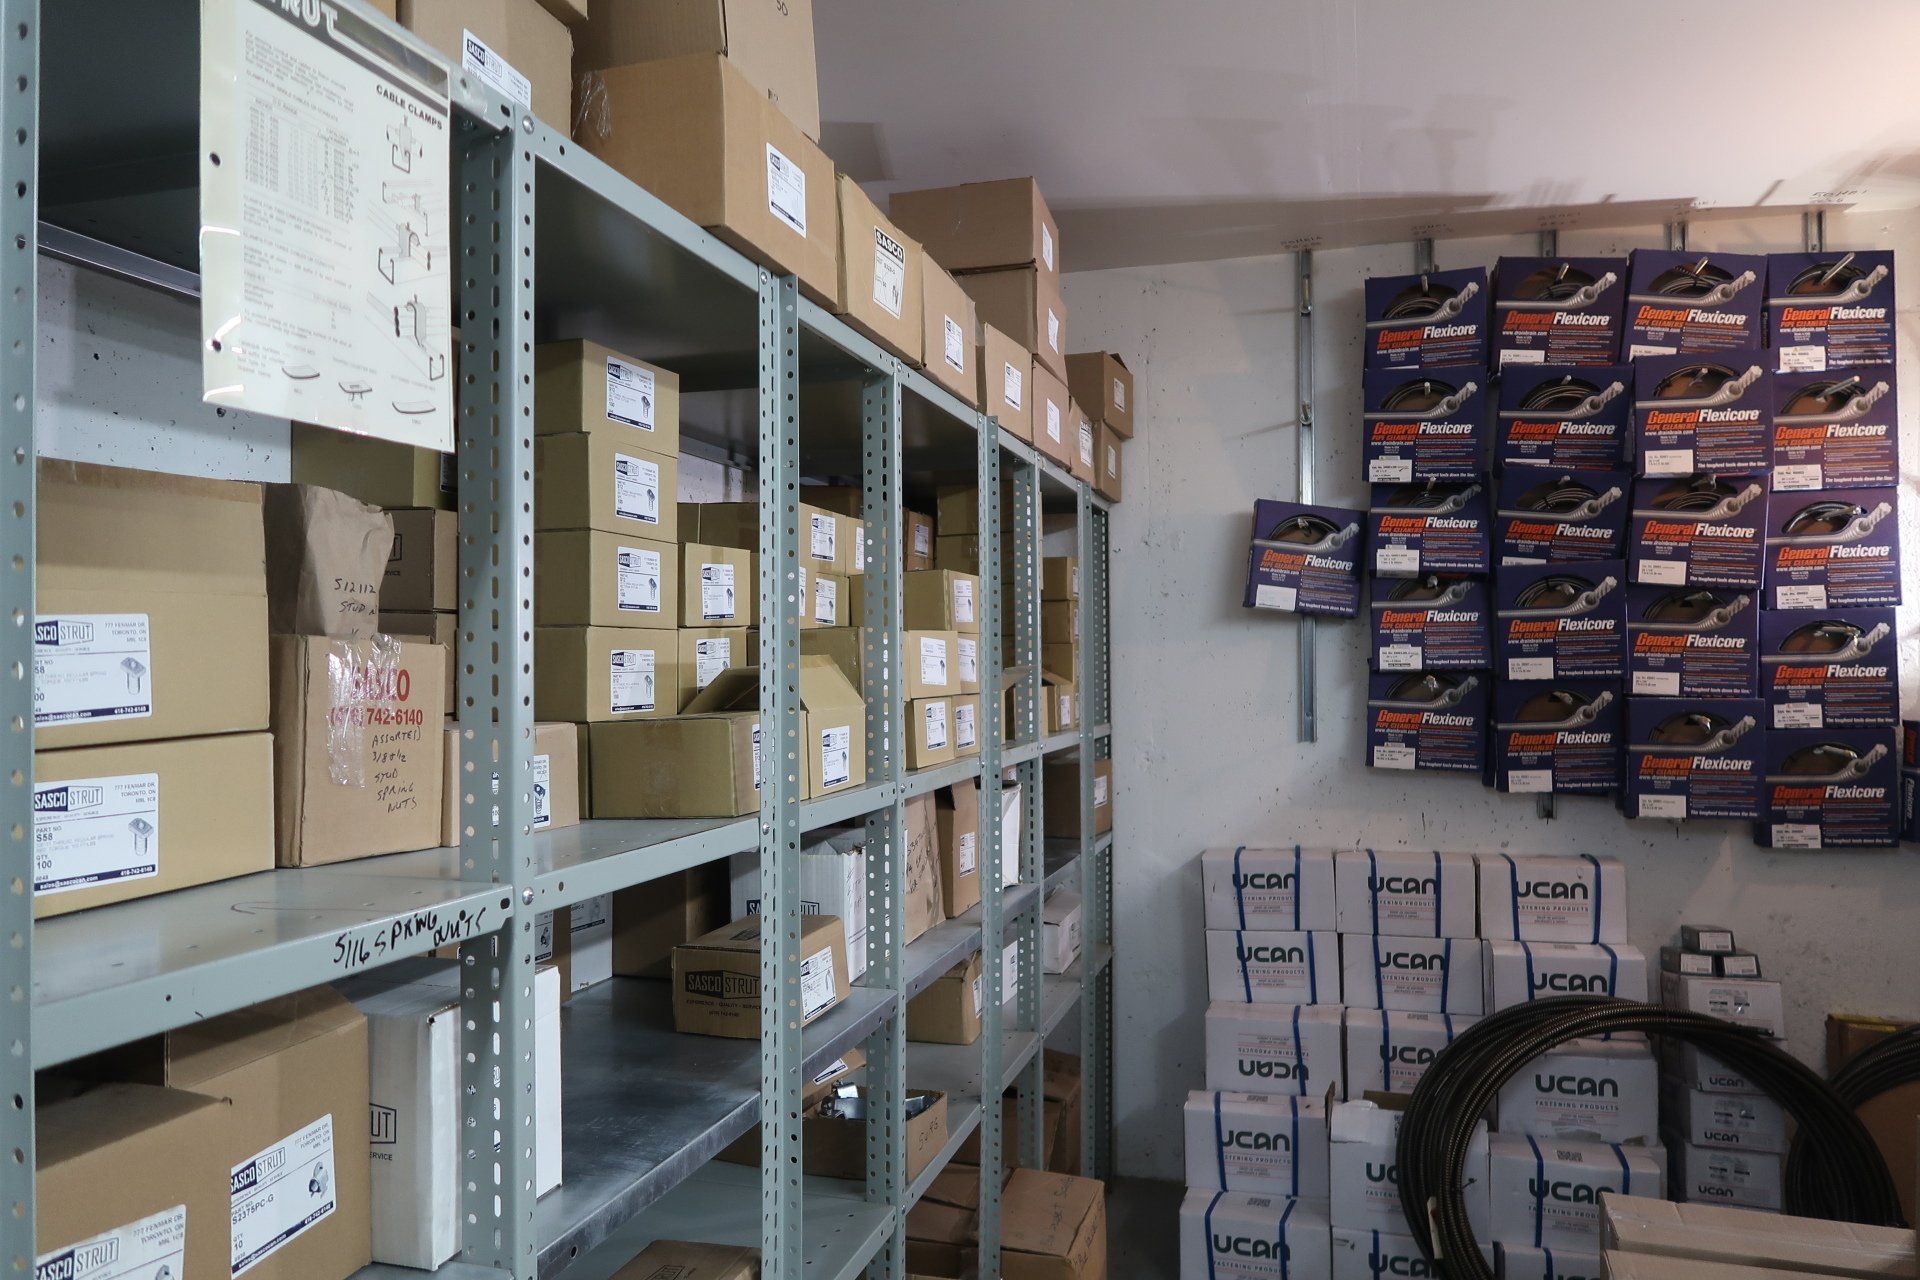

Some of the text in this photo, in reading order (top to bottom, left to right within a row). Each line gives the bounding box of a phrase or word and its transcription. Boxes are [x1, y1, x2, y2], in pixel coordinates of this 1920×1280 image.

[376, 84, 442, 130] CABLE CLAMPS
[876, 232, 903, 260] SASCO
[1505, 311, 1610, 325] General Flexicore
[1637, 305, 1746, 325] General Flexicore
[1782, 304, 1886, 322] General Flexicore
[1379, 323, 1476, 343] General Flexicore
[1646, 406, 1759, 425] General Flexicore
[1373, 421, 1472, 435] General Flexicore
[1510, 420, 1615, 434] General Flexicore
[1775, 421, 1886, 440] General Flexicore
[1380, 516, 1478, 528] General Flexicore
[1508, 520, 1613, 538] General Flexicore
[1644, 520, 1755, 537] General Flexicore
[1263, 549, 1353, 570] General Flexicore
[1778, 542, 1889, 561] General Flexicore
[1381, 609, 1479, 623] General Flexicore
[1509, 616, 1615, 633] General Flexicore
[60, 624, 90, 640] STRUT
[1636, 632, 1745, 647] General Flexicore
[1775, 663, 1887, 679] General Flexicore
[367, 708, 423, 726] 742-6140
[1377, 709, 1474, 726] General Flexicore
[1509, 730, 1611, 746] General Flexicore
[1641, 755, 1752, 770] General Flexicore
[375, 768, 398, 783] STUD
[35, 789, 100, 809] SASCO STRUT
[1825, 784, 1885, 799] Flexicore
[36, 833, 52, 842] S58
[37, 860, 52, 869] 100
[1516, 881, 1588, 899] UCAN
[688, 975, 759, 995] SASCO STRUT
[1535, 1074, 1618, 1097] UCAN
[1709, 1076, 1744, 1088] UCAN
[1705, 1132, 1739, 1143] UCAN
[257, 1150, 283, 1178] STRUT
[1698, 1184, 1733, 1197] UCAN
[232, 1194, 274, 1225] S2375PC-G
[234, 1241, 243, 1250] 10
[76, 1240, 115, 1272] STRUT
